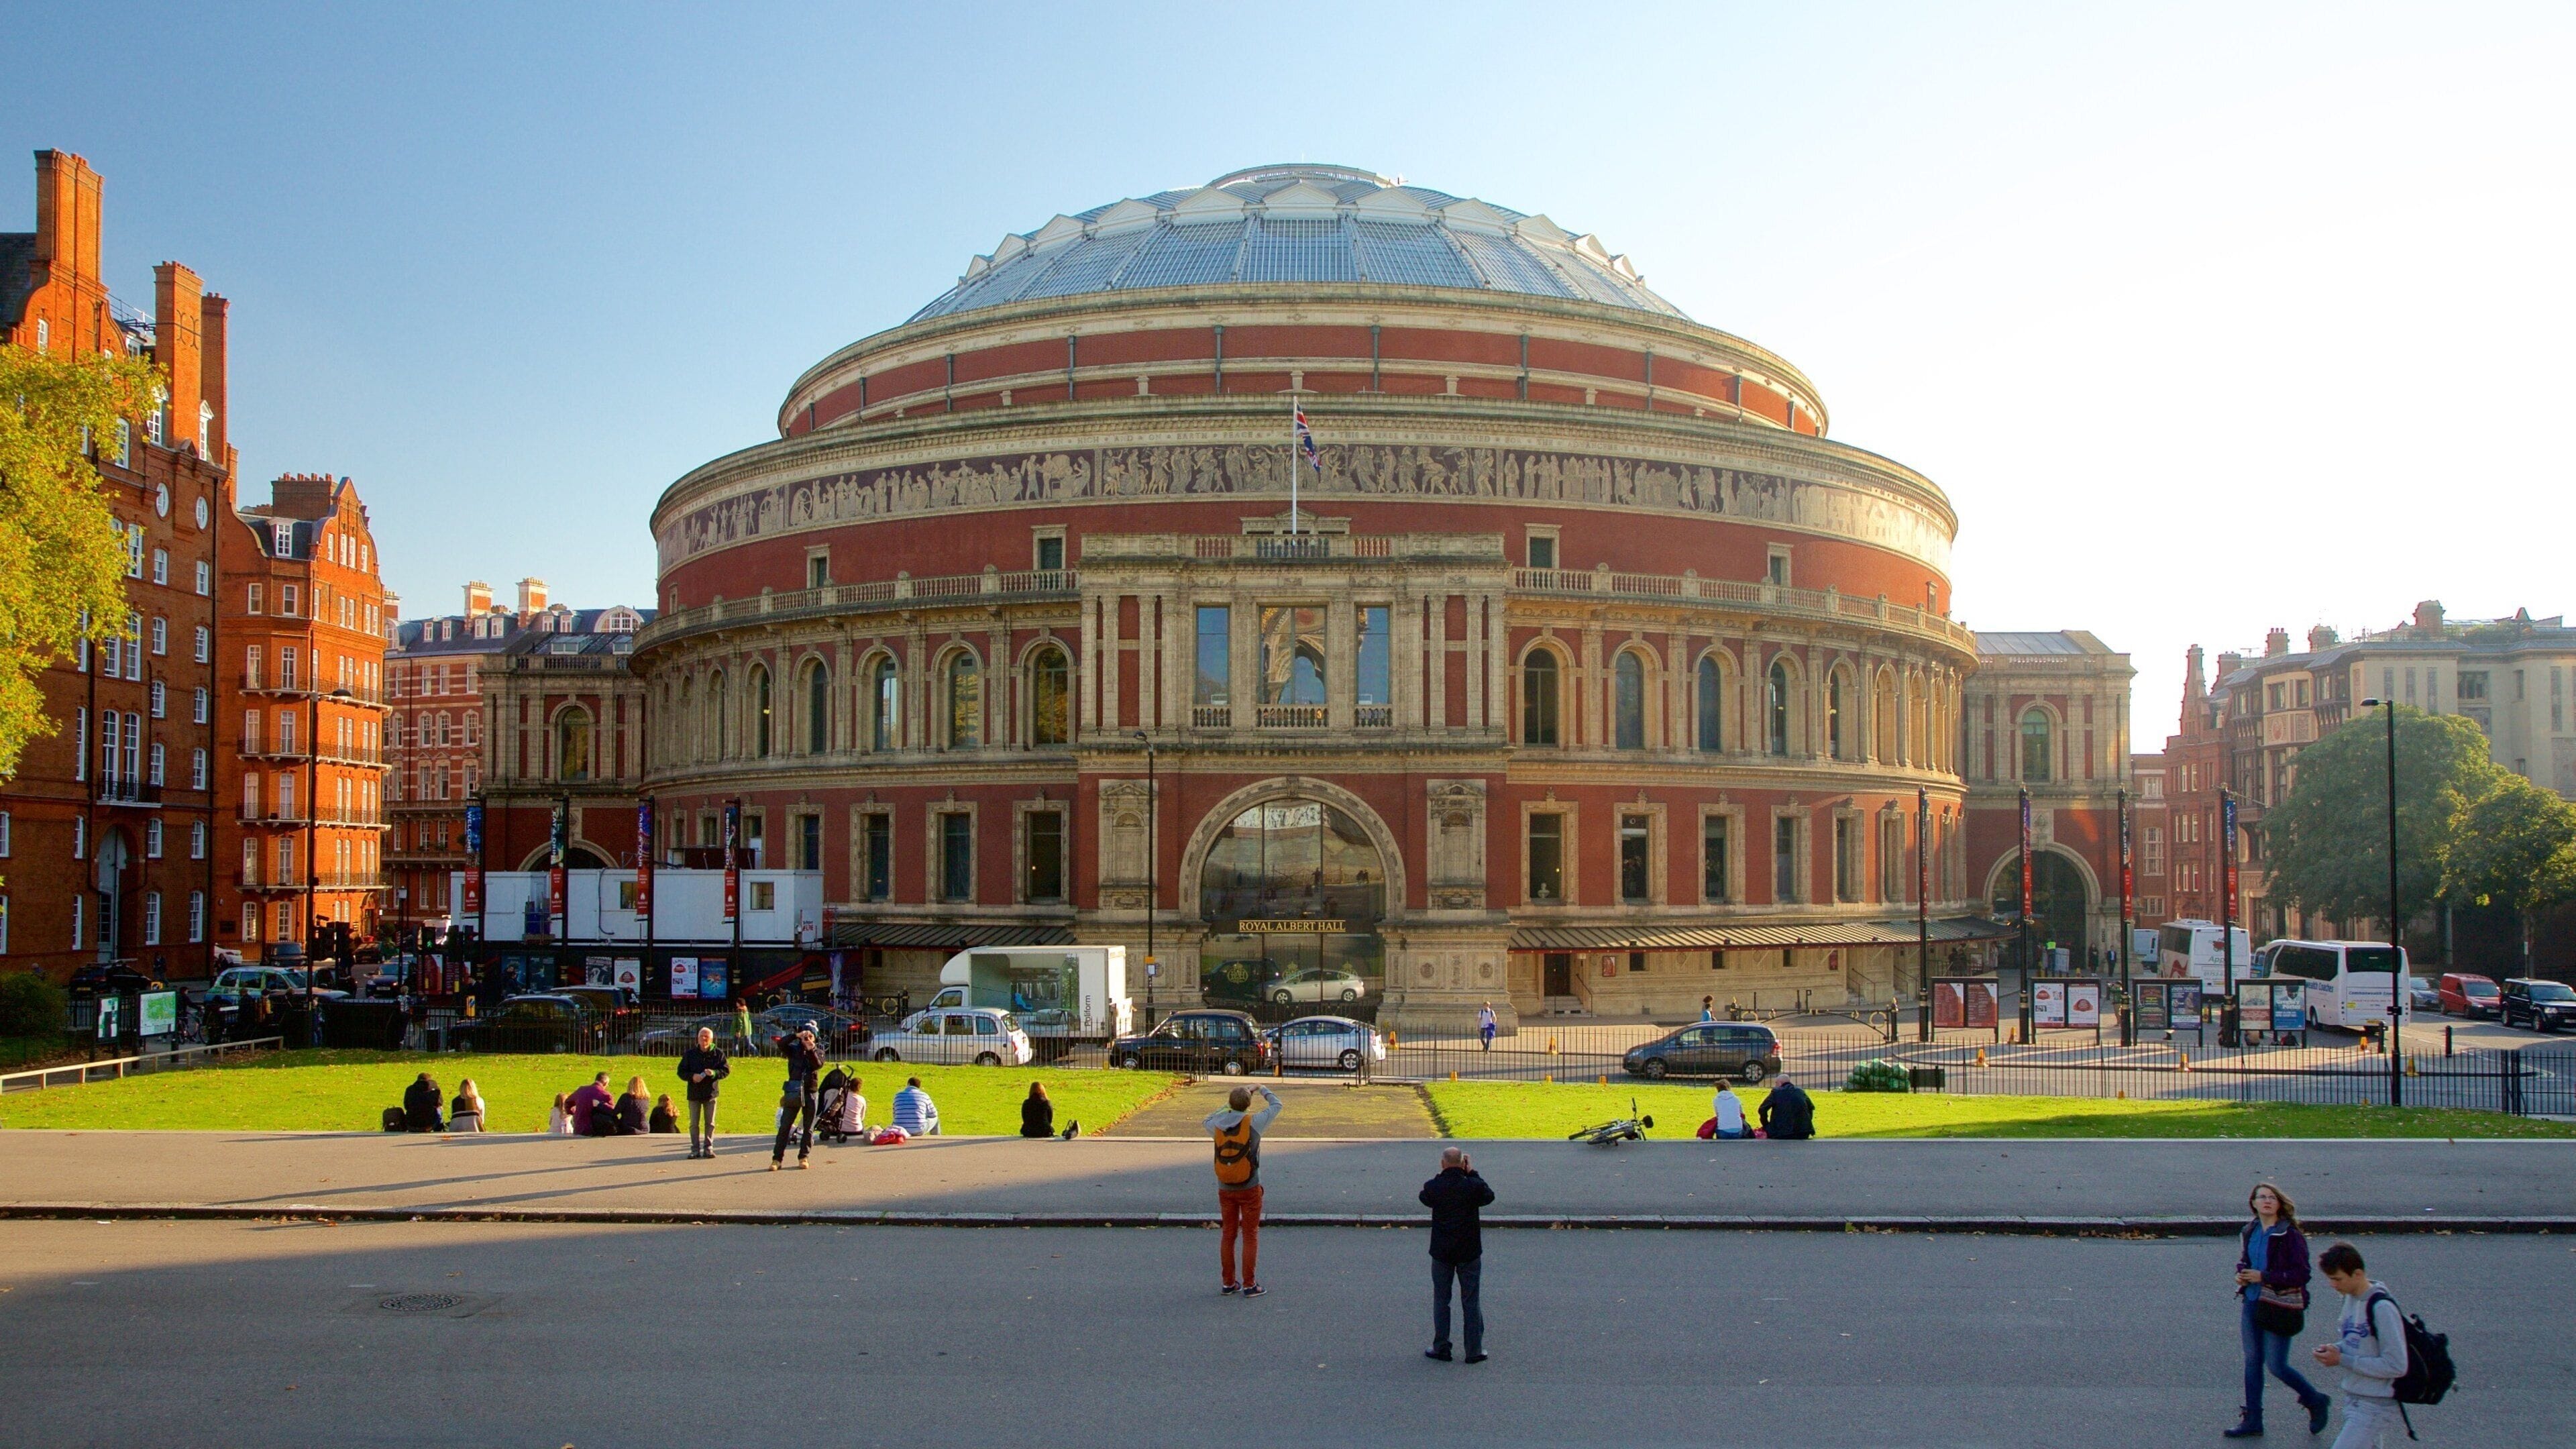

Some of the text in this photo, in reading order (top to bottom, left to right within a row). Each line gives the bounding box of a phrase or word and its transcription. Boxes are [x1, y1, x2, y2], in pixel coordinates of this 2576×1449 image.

[1450, 434, 1491, 442] ERECTED
[934, 447, 961, 456] GLORY
[1176, 432, 1208, 440] EARTH
[1239, 922, 1346, 931] ROYAL ALBERT HALL
[2208, 955, 2225, 963] App
